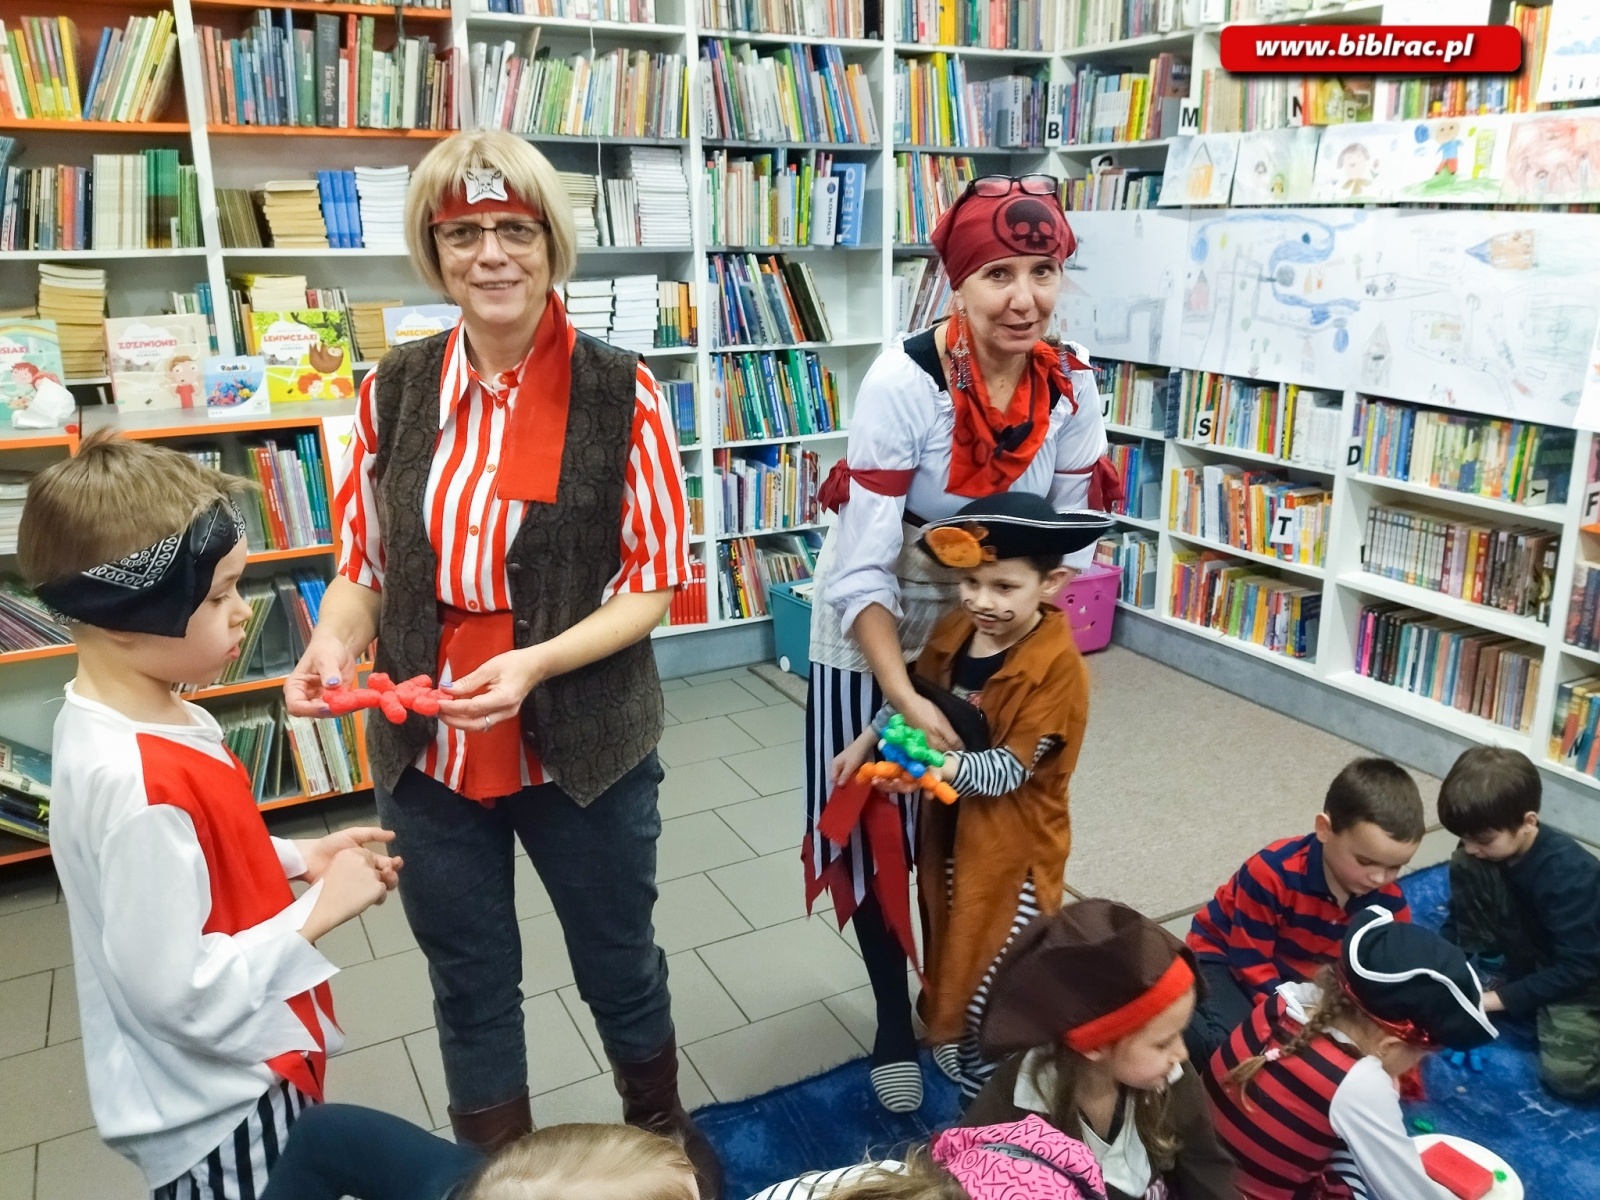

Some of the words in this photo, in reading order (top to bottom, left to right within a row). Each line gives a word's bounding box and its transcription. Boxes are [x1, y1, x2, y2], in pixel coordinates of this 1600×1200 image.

[324, 65, 335, 106] Biologia
[1182, 107, 1199, 127] M
[1048, 122, 1059, 139] B
[842, 167, 856, 239] NIEBO
[263, 334, 317, 342] LENIWCZAKI
[1101, 400, 1109, 417] J
[1198, 418, 1211, 436] S
[1347, 445, 1361, 466] D
[1531, 487, 1545, 497] Y
[1585, 491, 1600, 516] F
[1277, 515, 1292, 535] T
